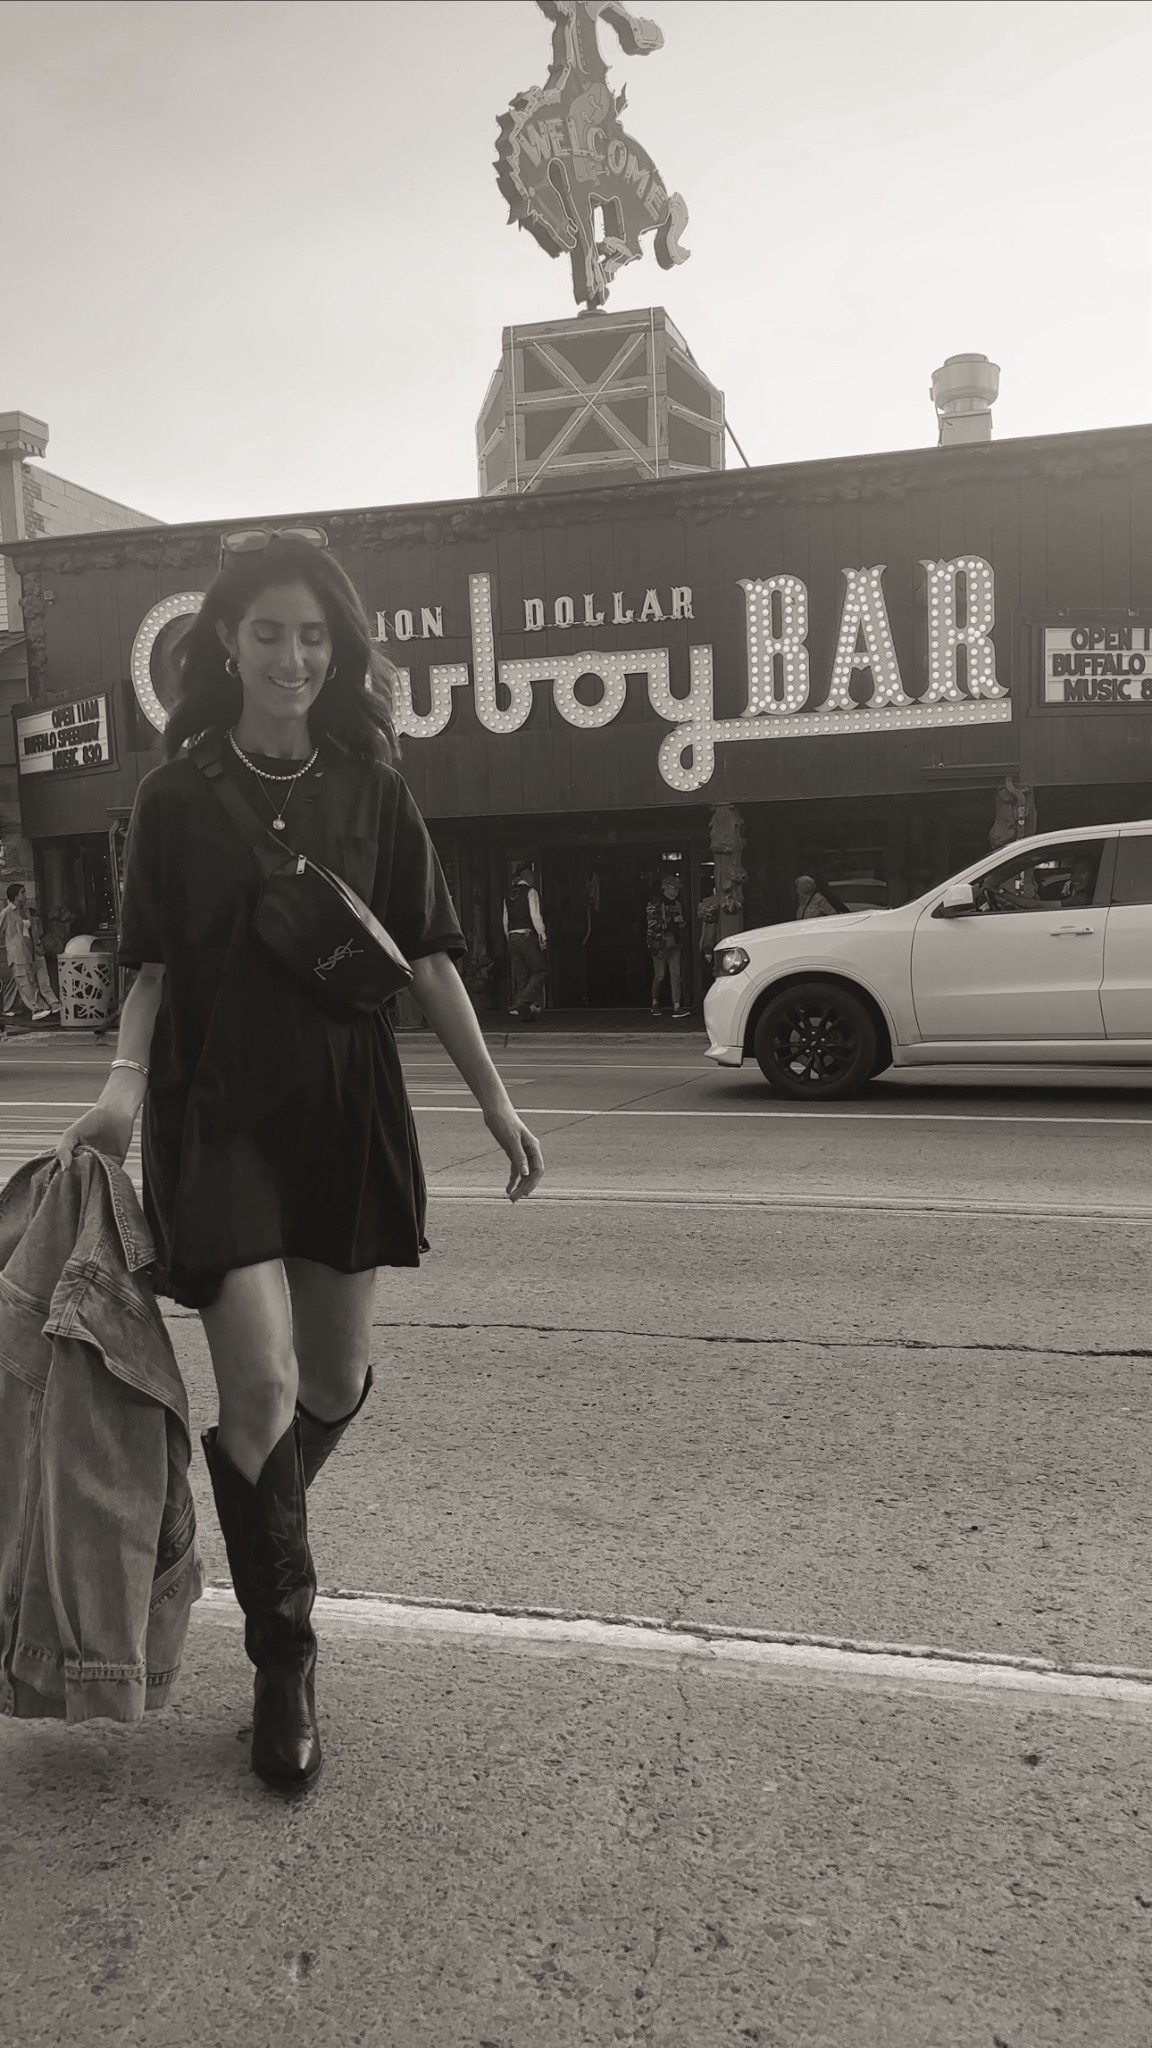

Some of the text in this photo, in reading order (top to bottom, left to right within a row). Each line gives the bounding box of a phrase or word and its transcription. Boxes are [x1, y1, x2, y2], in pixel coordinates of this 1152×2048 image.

[517, 116, 669, 222] WELCOME
[523, 586, 695, 631] DOLLAR
[735, 555, 1010, 717] BAR
[1071, 626, 1133, 651] OPEN
[1052, 653, 1146, 676] BUFFALO
[1064, 678, 1132, 701] MUSIC
